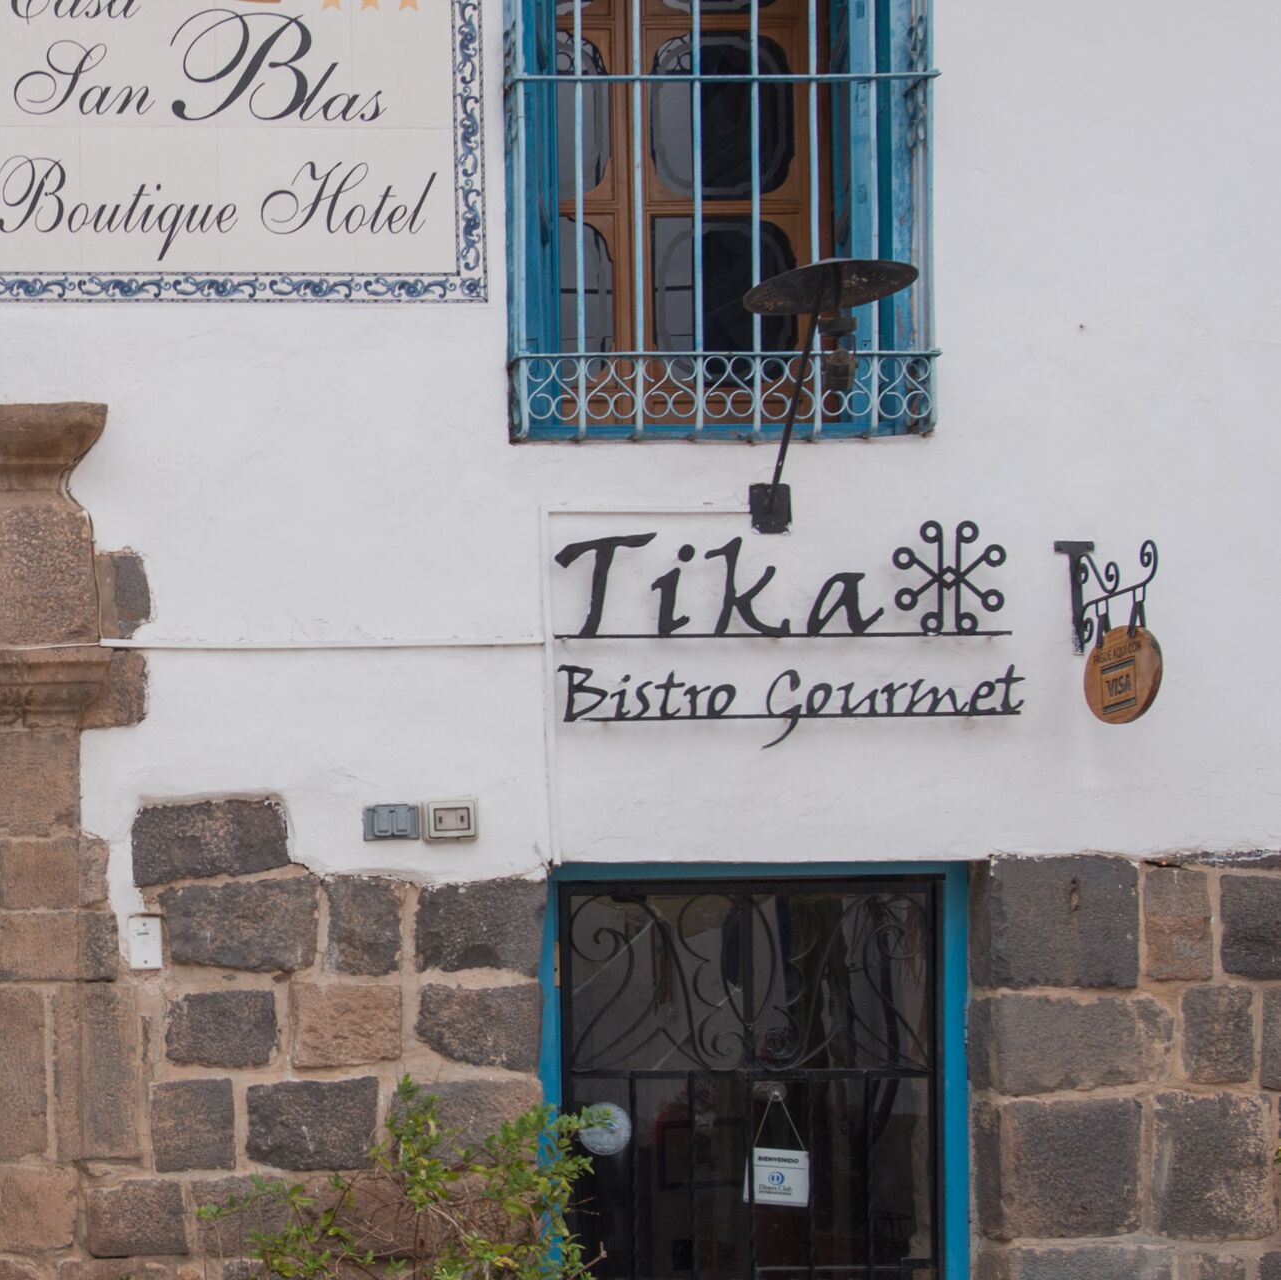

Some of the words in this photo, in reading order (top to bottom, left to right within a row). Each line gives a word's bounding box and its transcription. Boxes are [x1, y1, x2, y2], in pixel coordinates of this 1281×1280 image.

[13, 39, 156, 116] San
[170, 8, 388, 122] Blas
[260, 160, 438, 235] Hotel
[554, 531, 884, 637] Tika
[558, 665, 737, 721] Bistro
[761, 663, 1026, 750] Gourmet
[1105, 673, 1132, 698] VISA
[758, 1155, 799, 1164] BIENVENIDO
